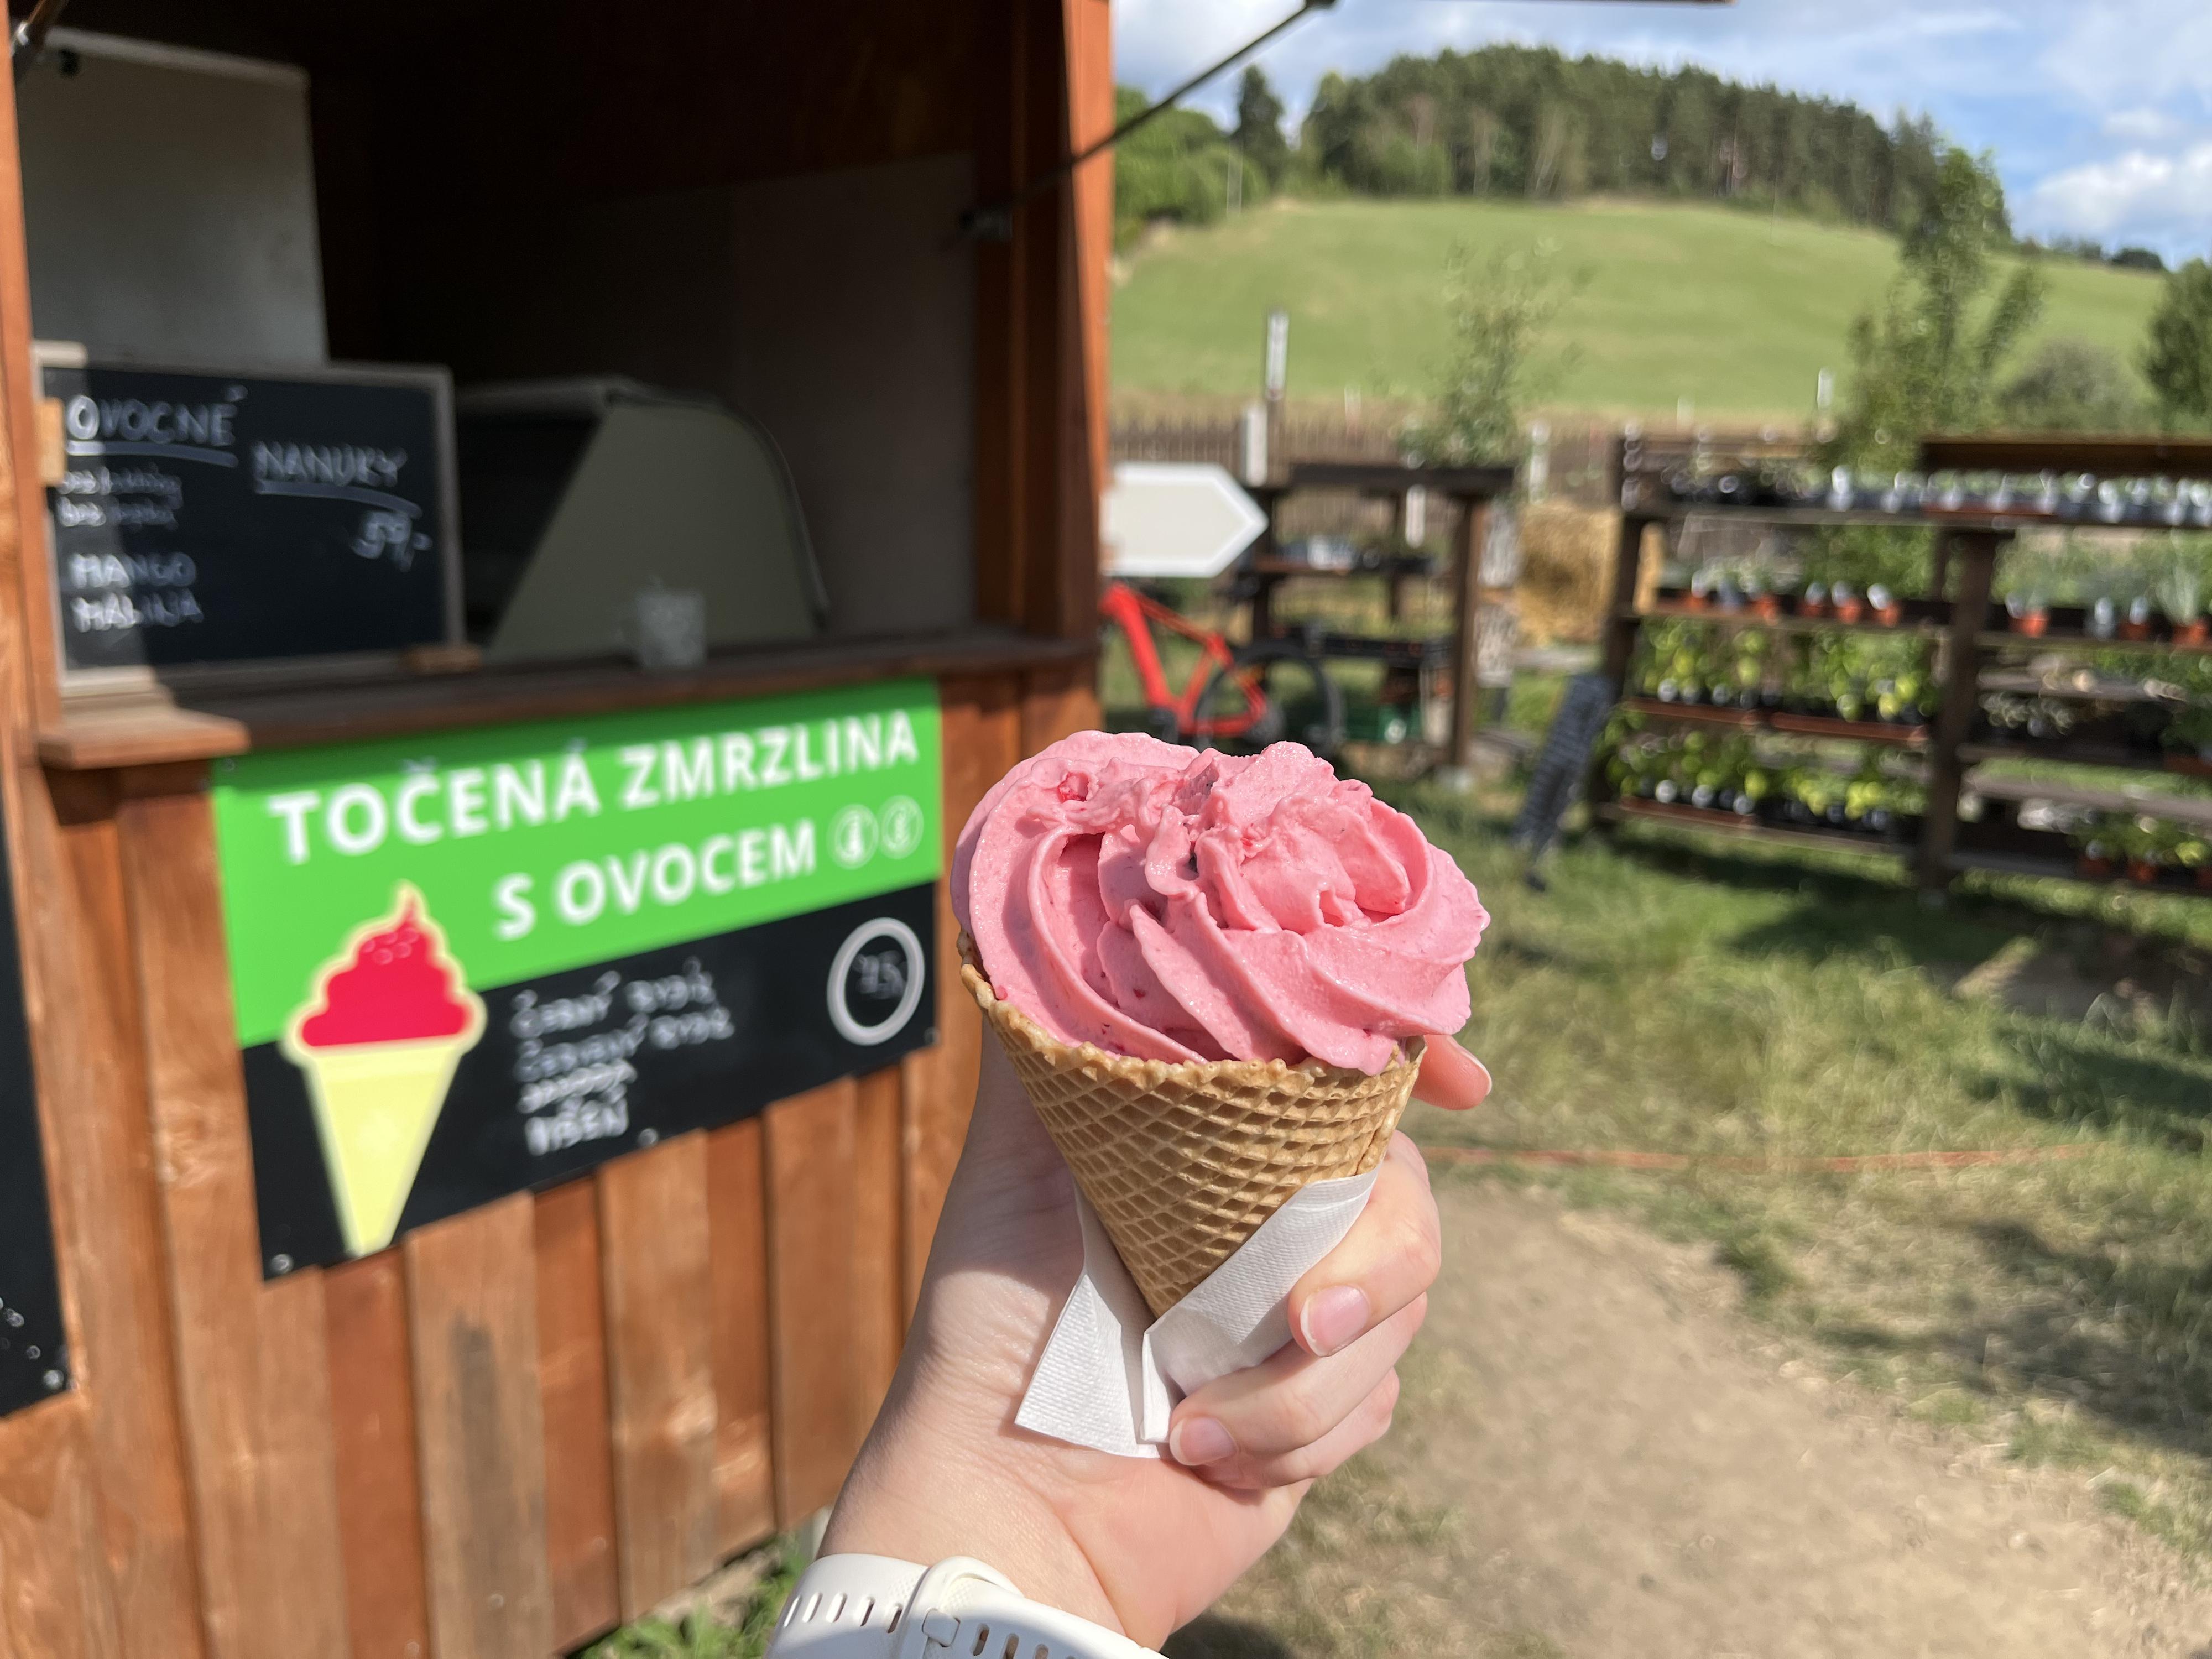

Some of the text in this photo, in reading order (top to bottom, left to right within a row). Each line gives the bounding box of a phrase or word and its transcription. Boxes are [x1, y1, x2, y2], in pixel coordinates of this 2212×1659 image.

[66, 385, 248, 446] OVOCNÉ
[266, 709, 919, 865] TOČENÁ ZMRZLINA
[494, 816, 817, 941] S OVOCEM
